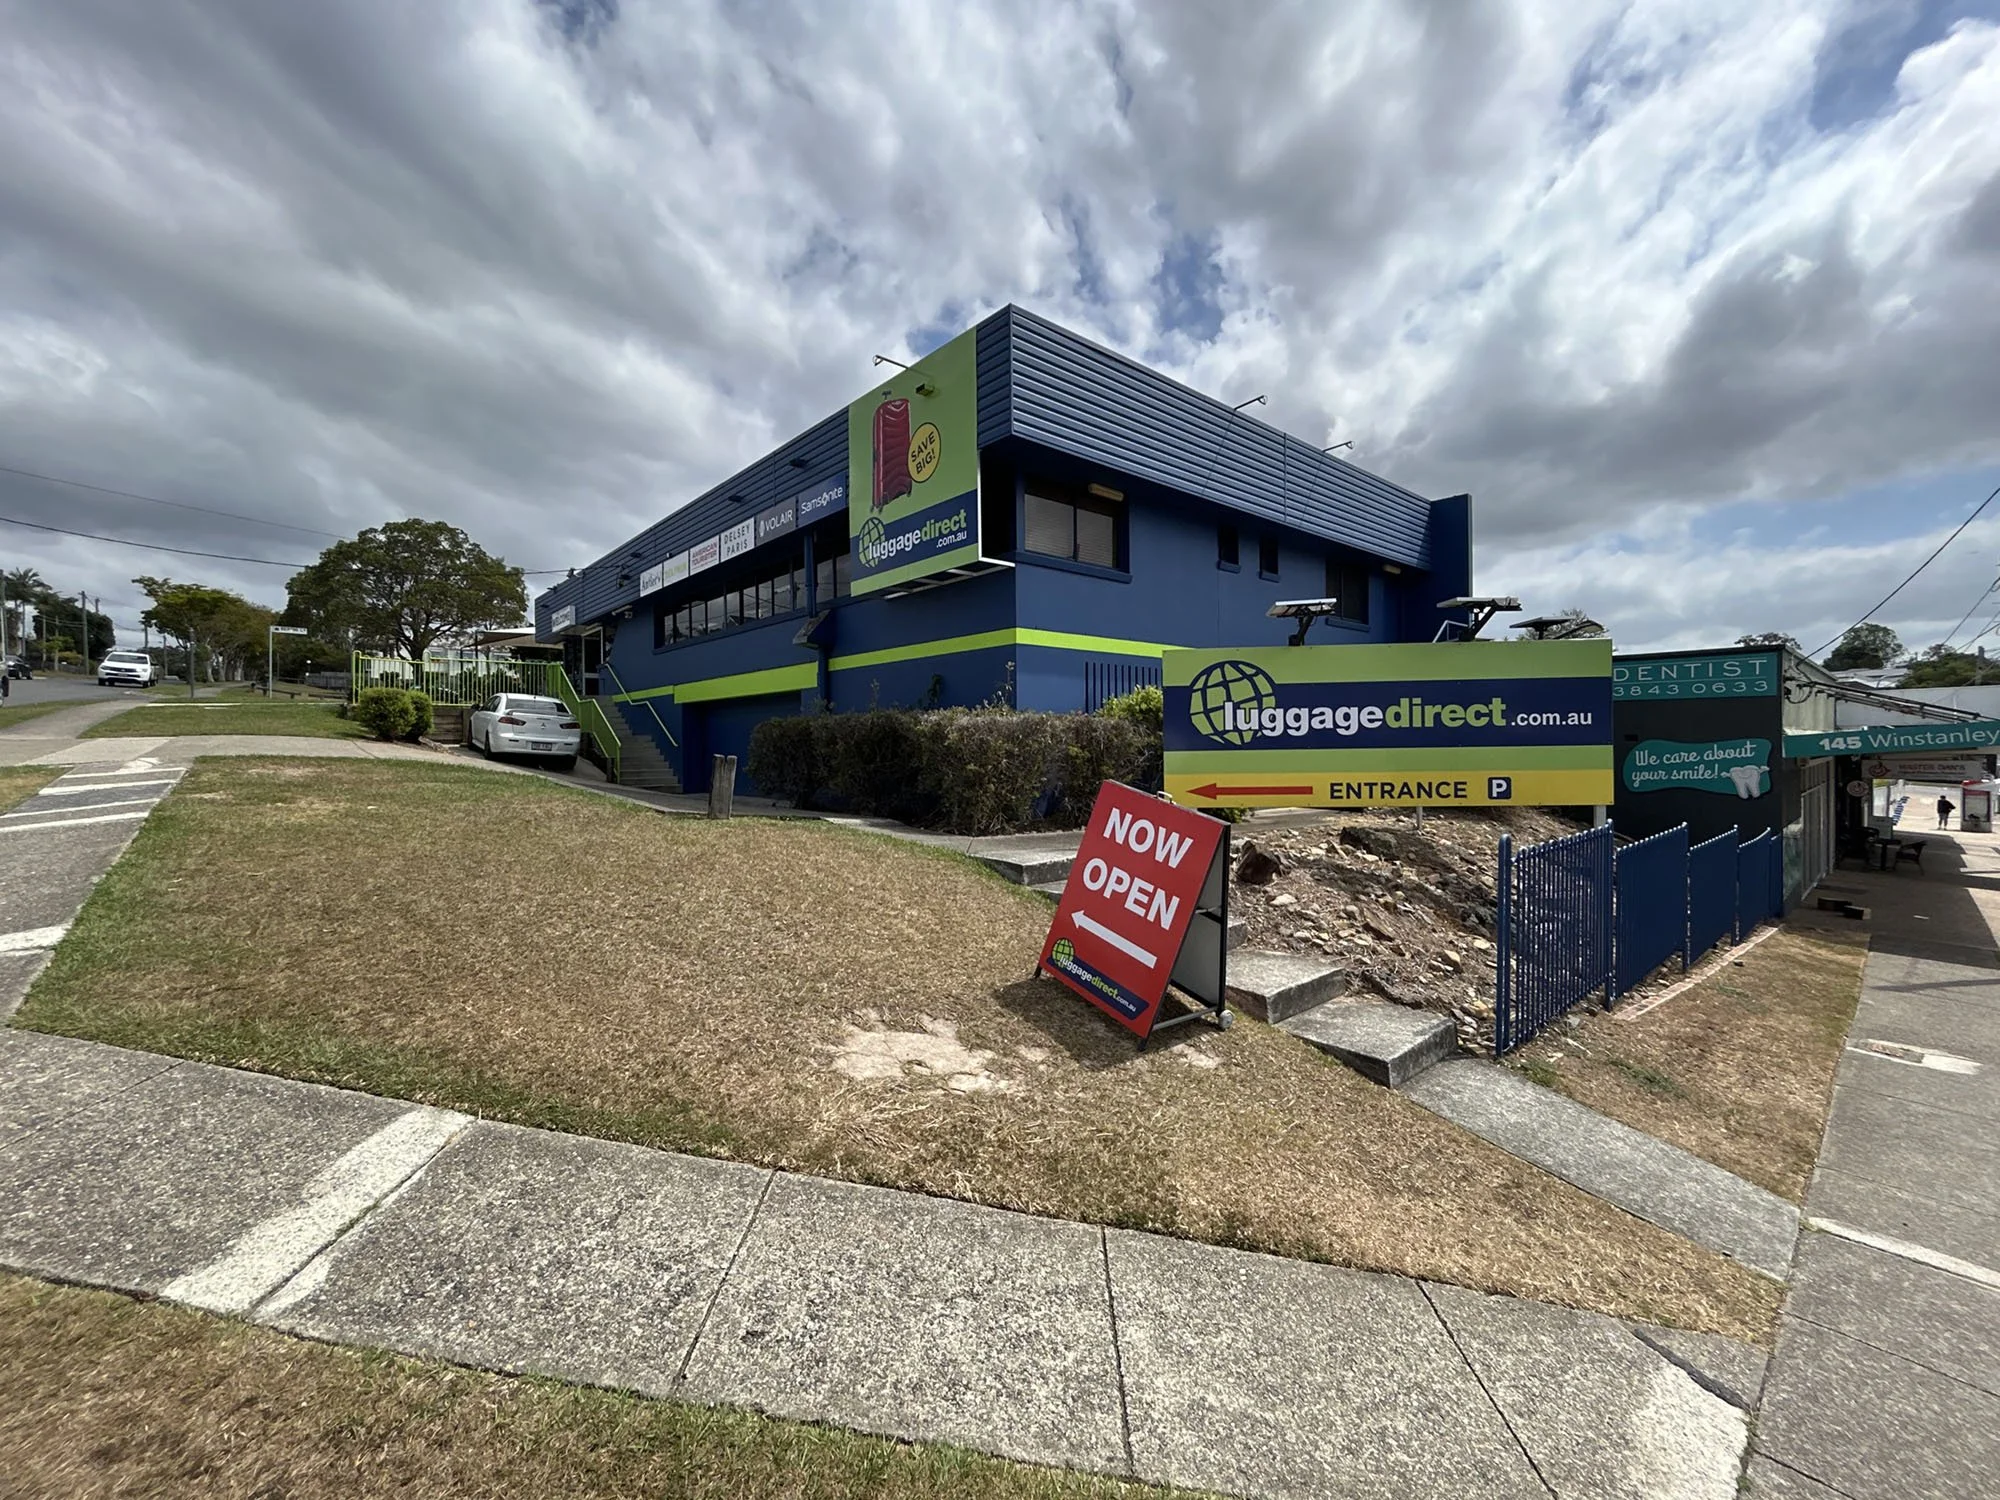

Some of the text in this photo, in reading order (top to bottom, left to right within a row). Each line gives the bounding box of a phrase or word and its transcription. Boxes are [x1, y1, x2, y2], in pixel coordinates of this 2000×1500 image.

[910, 431, 936, 463] SAVE
[915, 449, 936, 475] BIG!
[800, 485, 843, 515] Samsonite
[764, 509, 793, 532] VOLAIR
[724, 523, 751, 545] DELSEY
[869, 509, 967, 560] luggagedirect
[691, 541, 718, 559] AMERICAN
[726, 538, 748, 556] PARIS
[1613, 660, 1767, 682] DENTIST
[1612, 680, 1768, 697] 3843 0633
[1819, 727, 2000, 751] 145 Winstanley
[1634, 740, 1757, 767] We care about
[1631, 762, 1720, 790] your smile!
[1329, 779, 1507, 800] ENTRANCE P
[1102, 807, 1194, 870] NOW
[1082, 857, 1181, 931] OPEN
